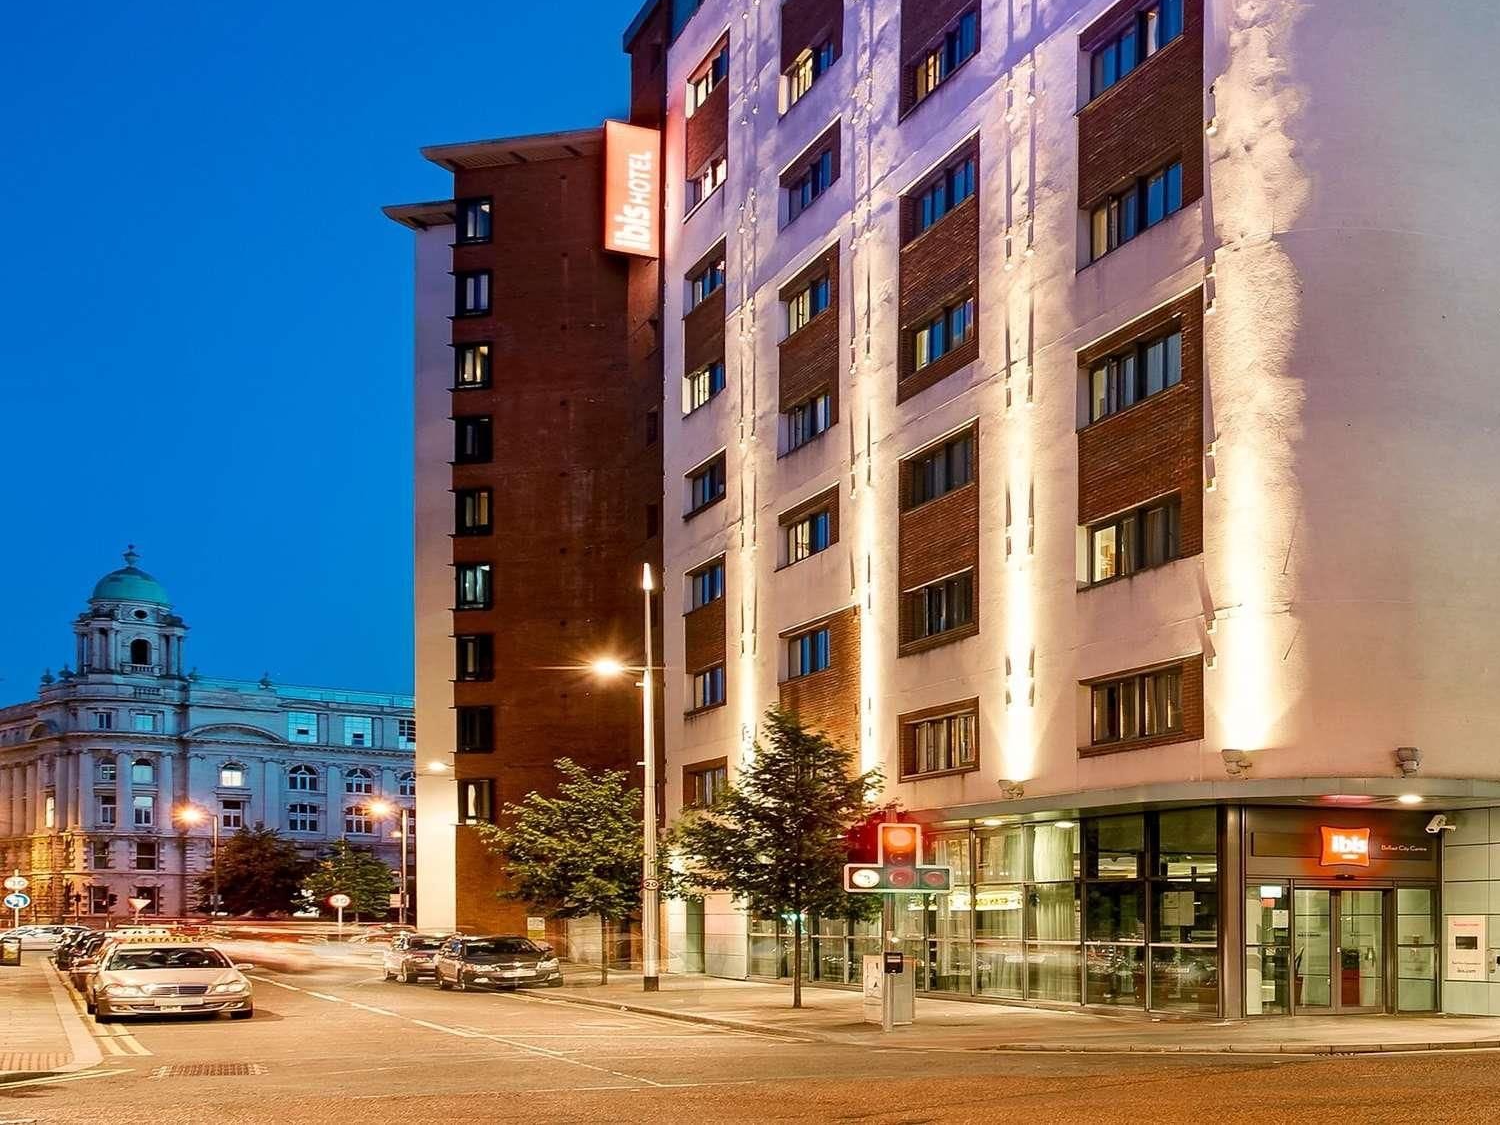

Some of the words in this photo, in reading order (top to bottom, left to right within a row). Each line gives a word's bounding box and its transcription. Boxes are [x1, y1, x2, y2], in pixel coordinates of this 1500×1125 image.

[627, 150, 653, 208] HOTEL
[613, 203, 652, 251] ibis
[1332, 834, 1368, 853] ibis
